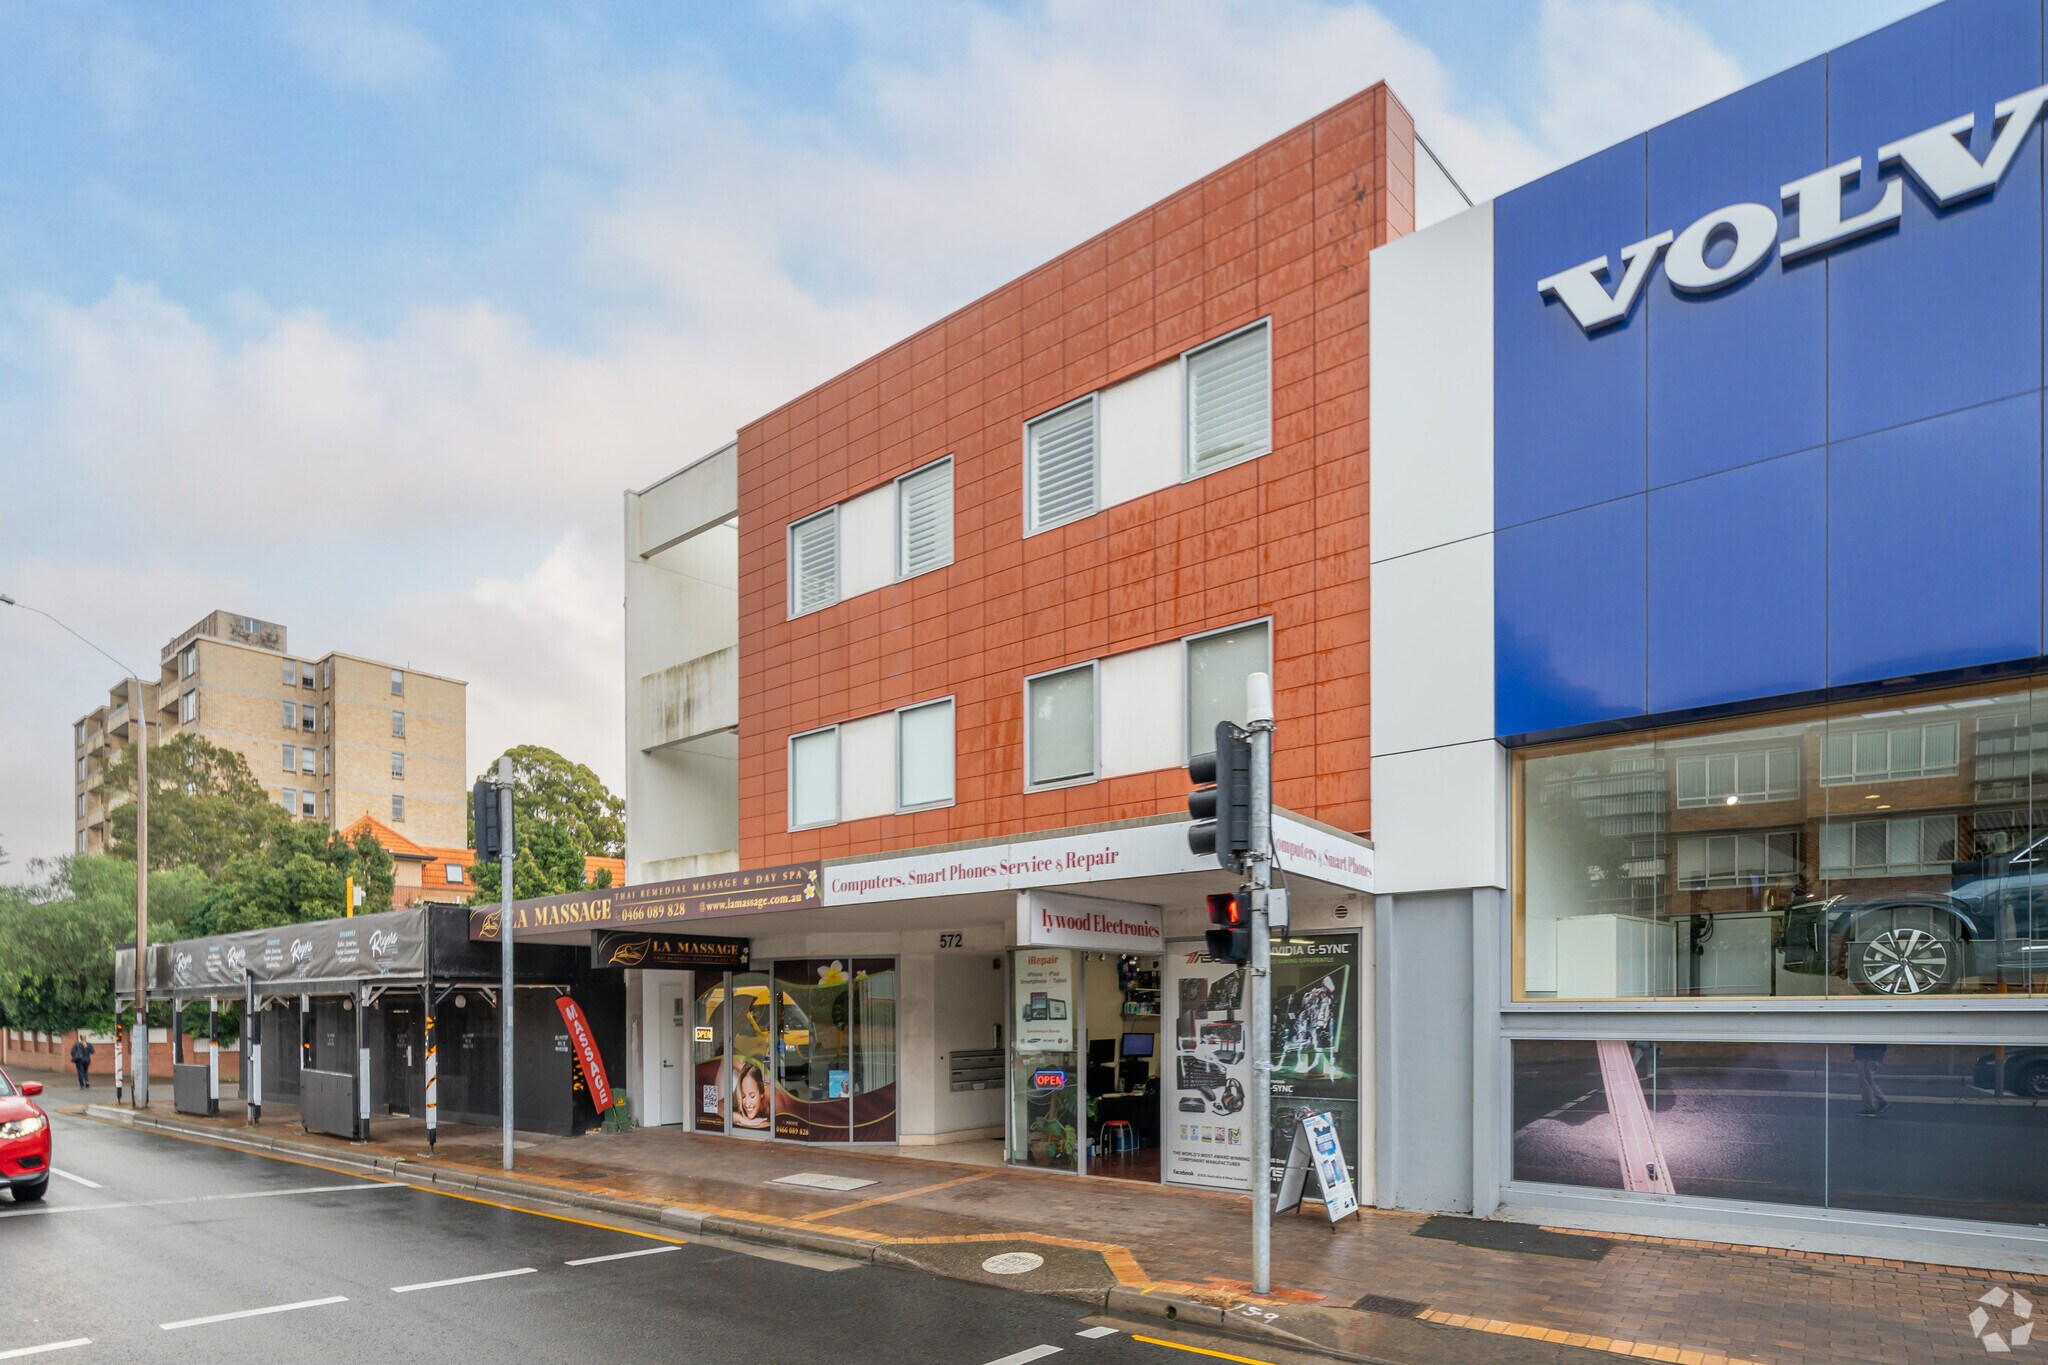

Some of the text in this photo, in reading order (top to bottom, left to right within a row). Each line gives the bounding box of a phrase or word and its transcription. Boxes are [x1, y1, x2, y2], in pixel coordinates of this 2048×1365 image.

[1537, 84, 2048, 334] VOLV
[908, 867, 947, 886] Smart
[950, 863, 997, 882] Phones
[1000, 855, 1053, 876] Service
[1065, 847, 1119, 872] Repair
[1270, 837, 1317, 861] omputers
[1323, 849, 1348, 871] Smart
[1348, 857, 1373, 878] Phones
[614, 870, 802, 901] THAI REMEDIAL MASSAGE & DAY SPA
[705, 893, 802, 911] www.lamassage.com.au
[534, 898, 612, 928] MASSAGE
[621, 902, 686, 922] 0466 089 828
[1093, 914, 1160, 938] Electronics
[653, 941, 739, 955] LA MASSAGE
[939, 933, 963, 948] 572
[1307, 943, 1350, 955] G-SYNC
[1028, 955, 1059, 967] iRepair
[697, 1030, 711, 1039] OPEN
[565, 1004, 608, 1105] MASSAGE
[1036, 1075, 1062, 1086] OPEN
[1270, 1085, 1294, 1093] -SYNC
